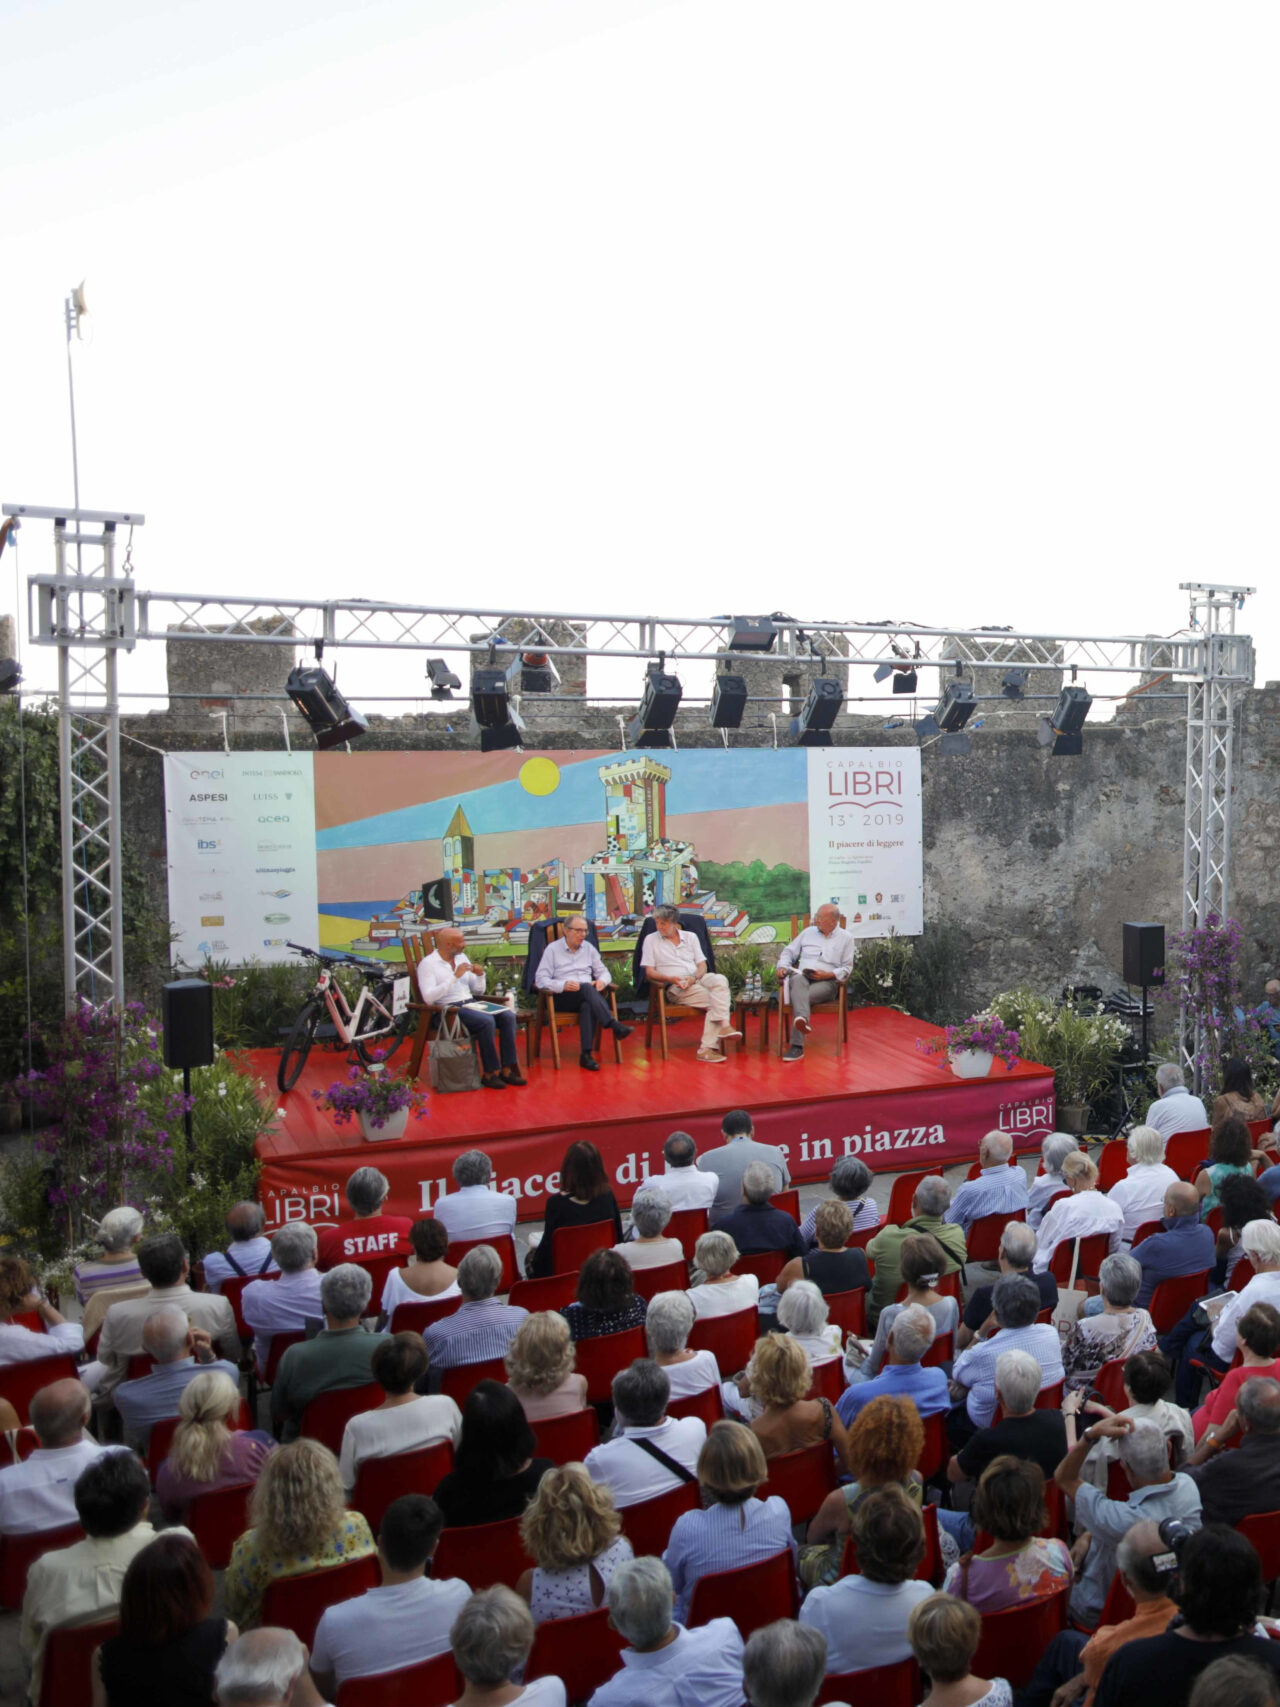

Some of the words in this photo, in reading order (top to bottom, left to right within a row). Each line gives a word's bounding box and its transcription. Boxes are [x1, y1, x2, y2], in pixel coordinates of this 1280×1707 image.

[826, 760, 904, 769] CAPALBIO
[828, 770, 902, 797] LIBRI
[189, 793, 228, 802] ASPESI
[252, 793, 280, 801] LUISS
[257, 815, 290, 823] acea
[862, 813, 904, 827] 2019
[197, 839, 217, 850] ibs
[828, 840, 836, 848] Il
[836, 840, 865, 851] piacere
[865, 839, 875, 848] di
[875, 839, 904, 850] leggere
[999, 1097, 1054, 1110] CAPALBIO
[998, 1104, 1054, 1131] LIBRI
[418, 1178, 447, 1212] Il
[615, 1152, 650, 1185] di
[799, 1133, 834, 1162] in
[842, 1124, 946, 1159] piazza
[343, 1232, 400, 1256] STAFF
